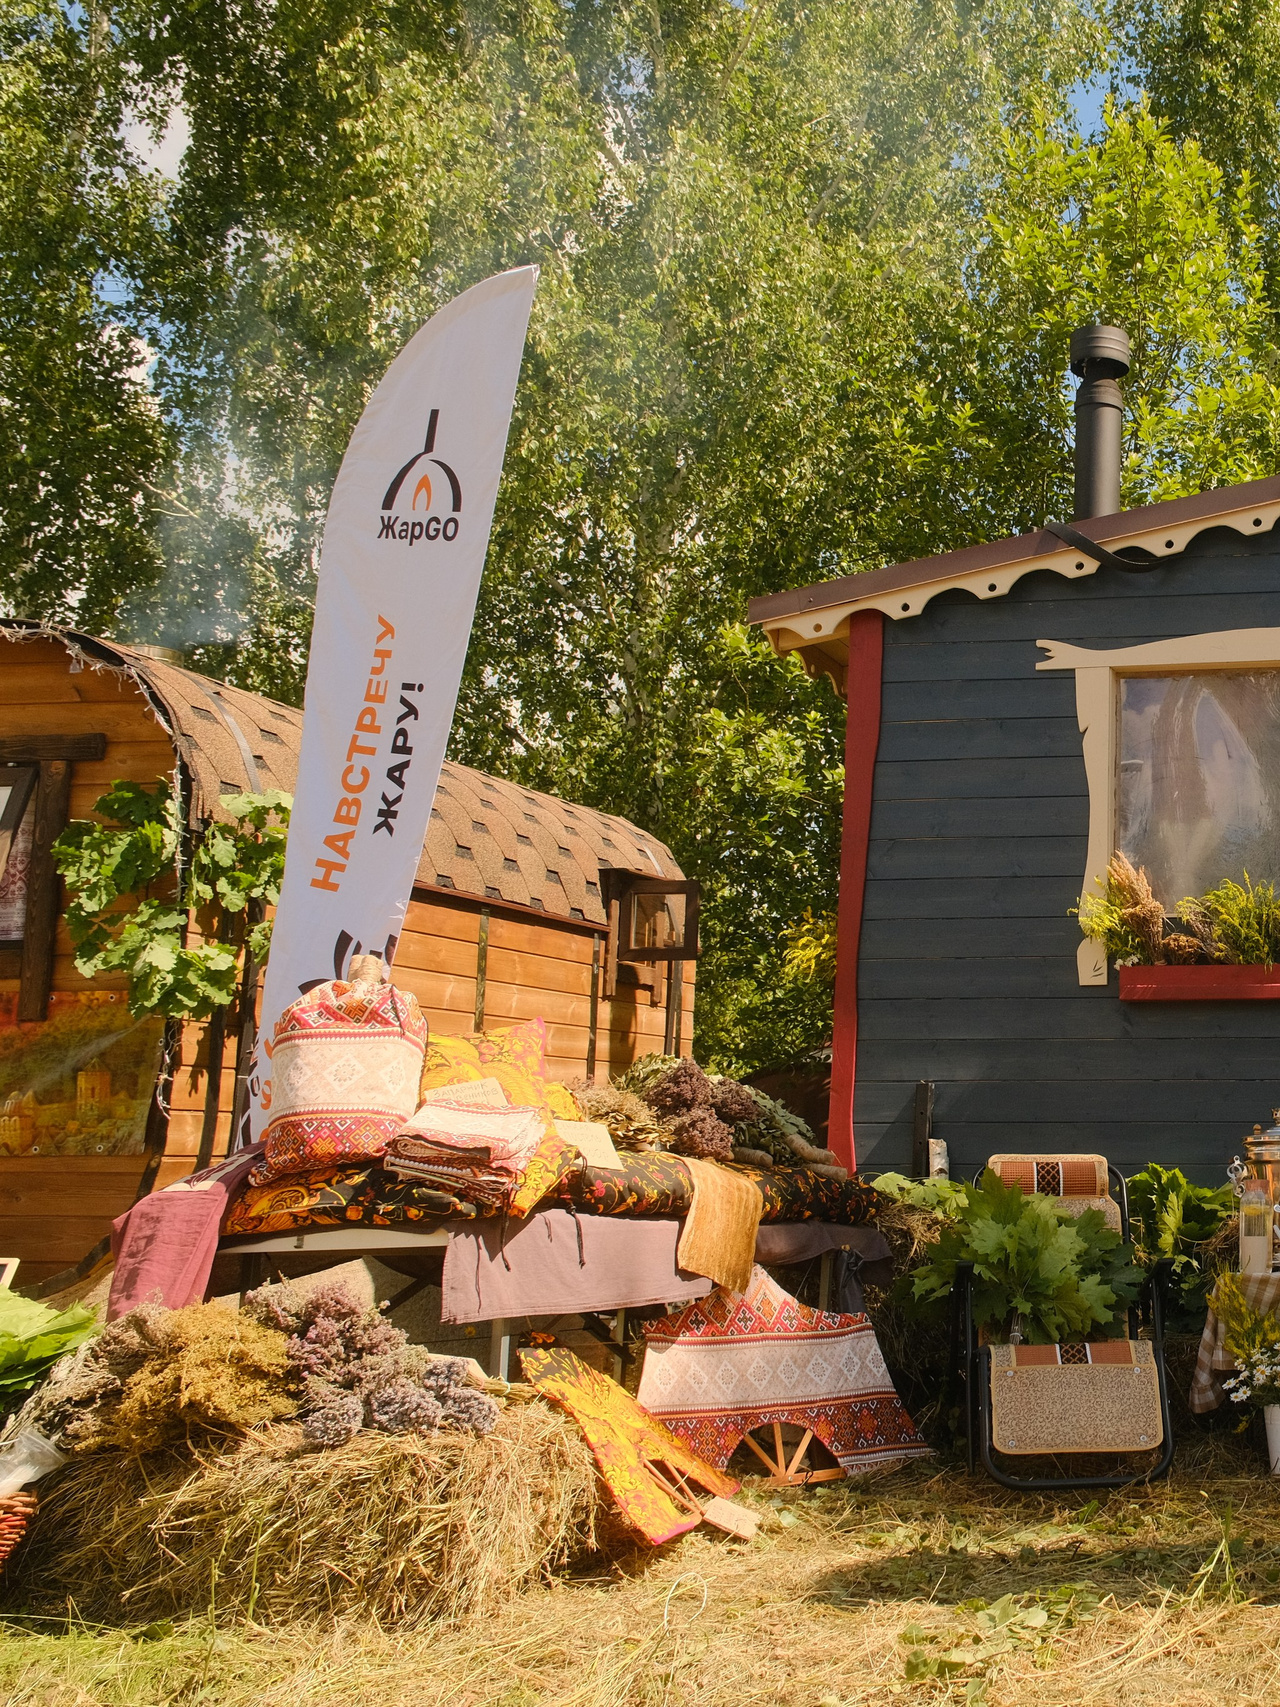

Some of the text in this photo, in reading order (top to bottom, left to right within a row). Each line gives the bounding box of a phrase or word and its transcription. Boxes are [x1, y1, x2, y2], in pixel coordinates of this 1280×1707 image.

[376, 514, 460, 546] ЖарGO
[309, 613, 396, 893] НАВСТРЕЧУ
[372, 682, 424, 838] ЖАРУ!
